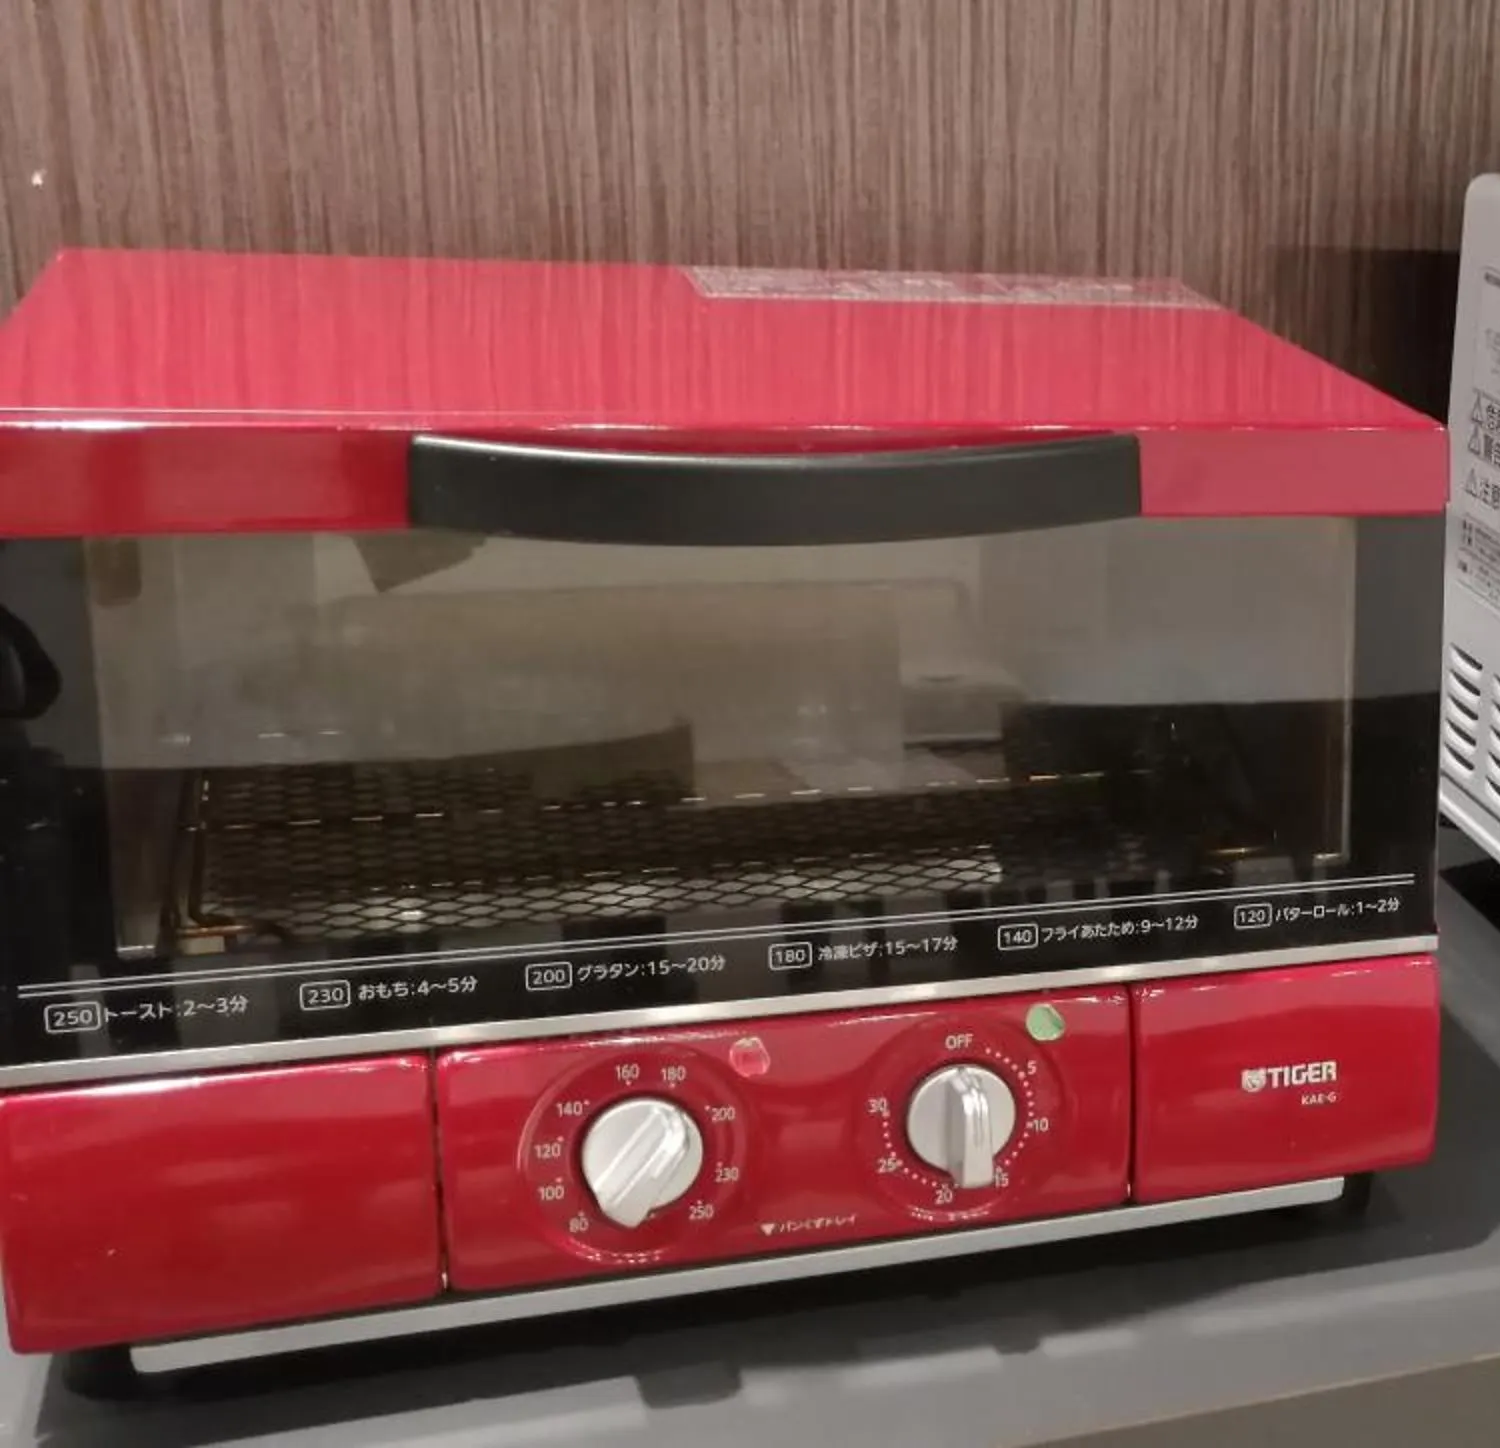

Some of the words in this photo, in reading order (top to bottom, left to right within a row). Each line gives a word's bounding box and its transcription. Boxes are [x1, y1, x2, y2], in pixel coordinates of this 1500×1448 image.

[1239, 909, 1267, 924] 120
[1003, 929, 1033, 945] 140
[775, 949, 806, 964] 180
[531, 968, 566, 985] 200
[307, 987, 344, 1004] 230
[53, 1008, 93, 1027] 250
[945, 1033, 974, 1050] OFF
[614, 1063, 640, 1081] 160
[660, 1065, 686, 1082] 180
[1027, 1060, 1037, 1075] 5
[1267, 1060, 1337, 1089] TIGER
[556, 1101, 583, 1116] 140
[868, 1097, 888, 1113] 30
[711, 1106, 736, 1122] 200
[1033, 1117, 1049, 1132] 10
[534, 1143, 561, 1158] 120
[715, 1166, 739, 1182] 230
[877, 1158, 897, 1174] 25
[994, 1173, 1009, 1188] 15
[538, 1186, 565, 1201] 100
[935, 1188, 953, 1205] 20
[689, 1204, 714, 1221] 250
[569, 1215, 589, 1233] 80
